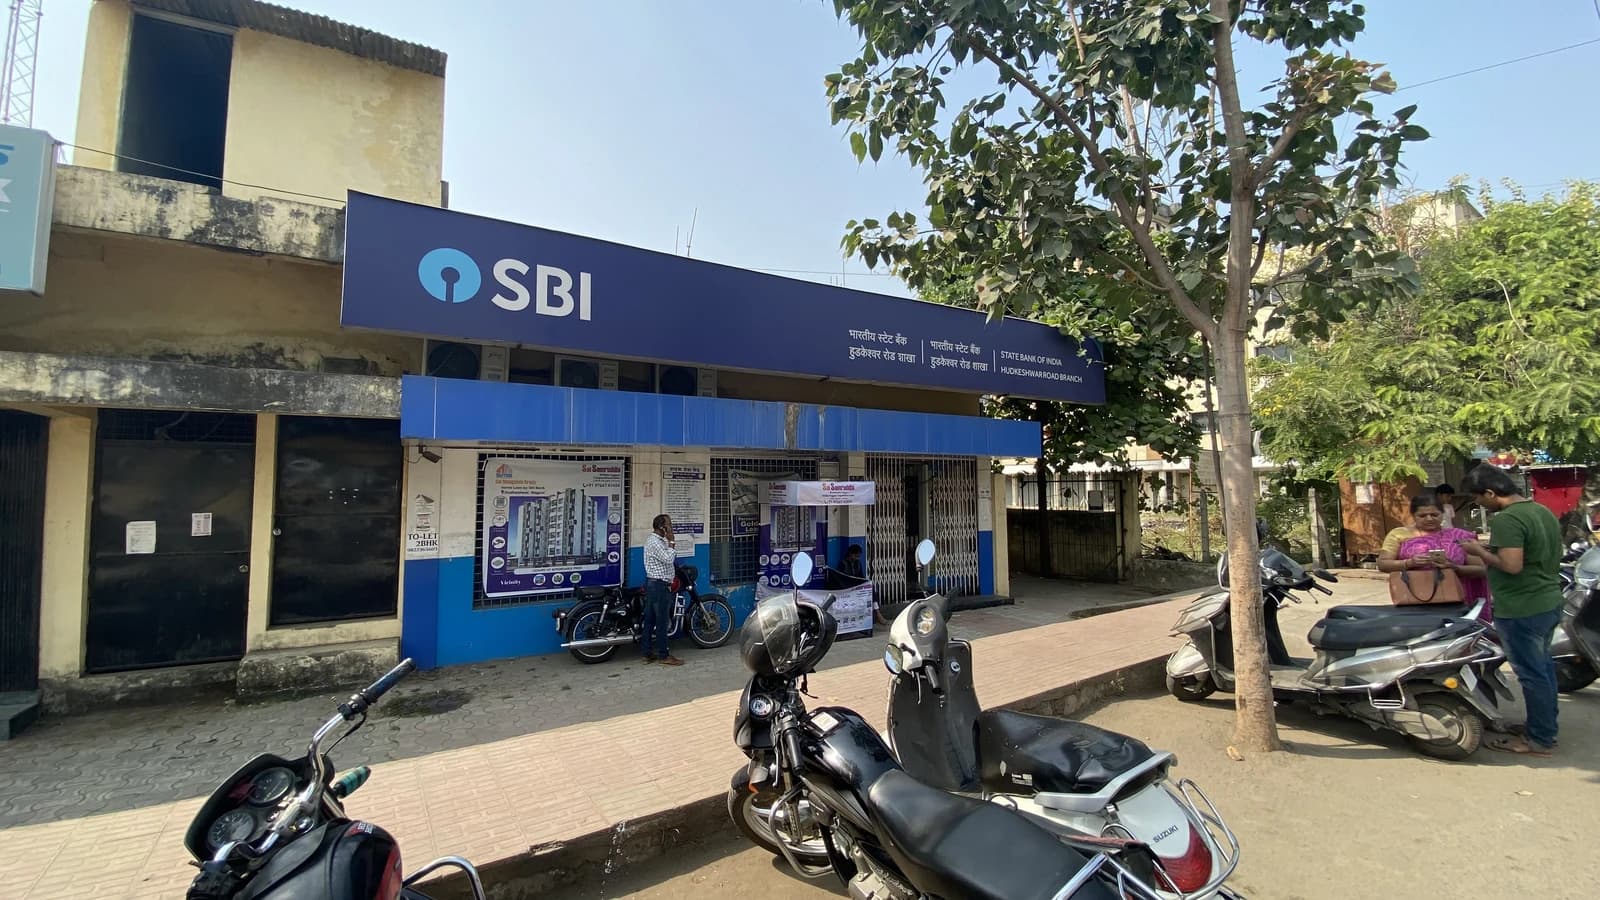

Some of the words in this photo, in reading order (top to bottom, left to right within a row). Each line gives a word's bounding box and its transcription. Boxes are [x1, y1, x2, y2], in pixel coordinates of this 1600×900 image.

[491, 258, 591, 321] SBI
[849, 329, 876, 342] भारतीय
[878, 331, 893, 344] स्टेट
[930, 340, 953, 352] भारतीय
[883, 348, 896, 361] रोड
[898, 353, 916, 363] शाखा
[1000, 350, 1019, 361] STATE
[1020, 353, 1036, 363] BANK
[1037, 356, 1045, 364] OF
[1046, 358, 1062, 367] INDIA
[1000, 366, 1042, 379] HUDKESHWAR
[1043, 371, 1059, 381] ROAD
[1060, 373, 1083, 384] BRANCH
[408, 533, 437, 541] TO-LET
[1153, 825, 1179, 843] SUZUKI
